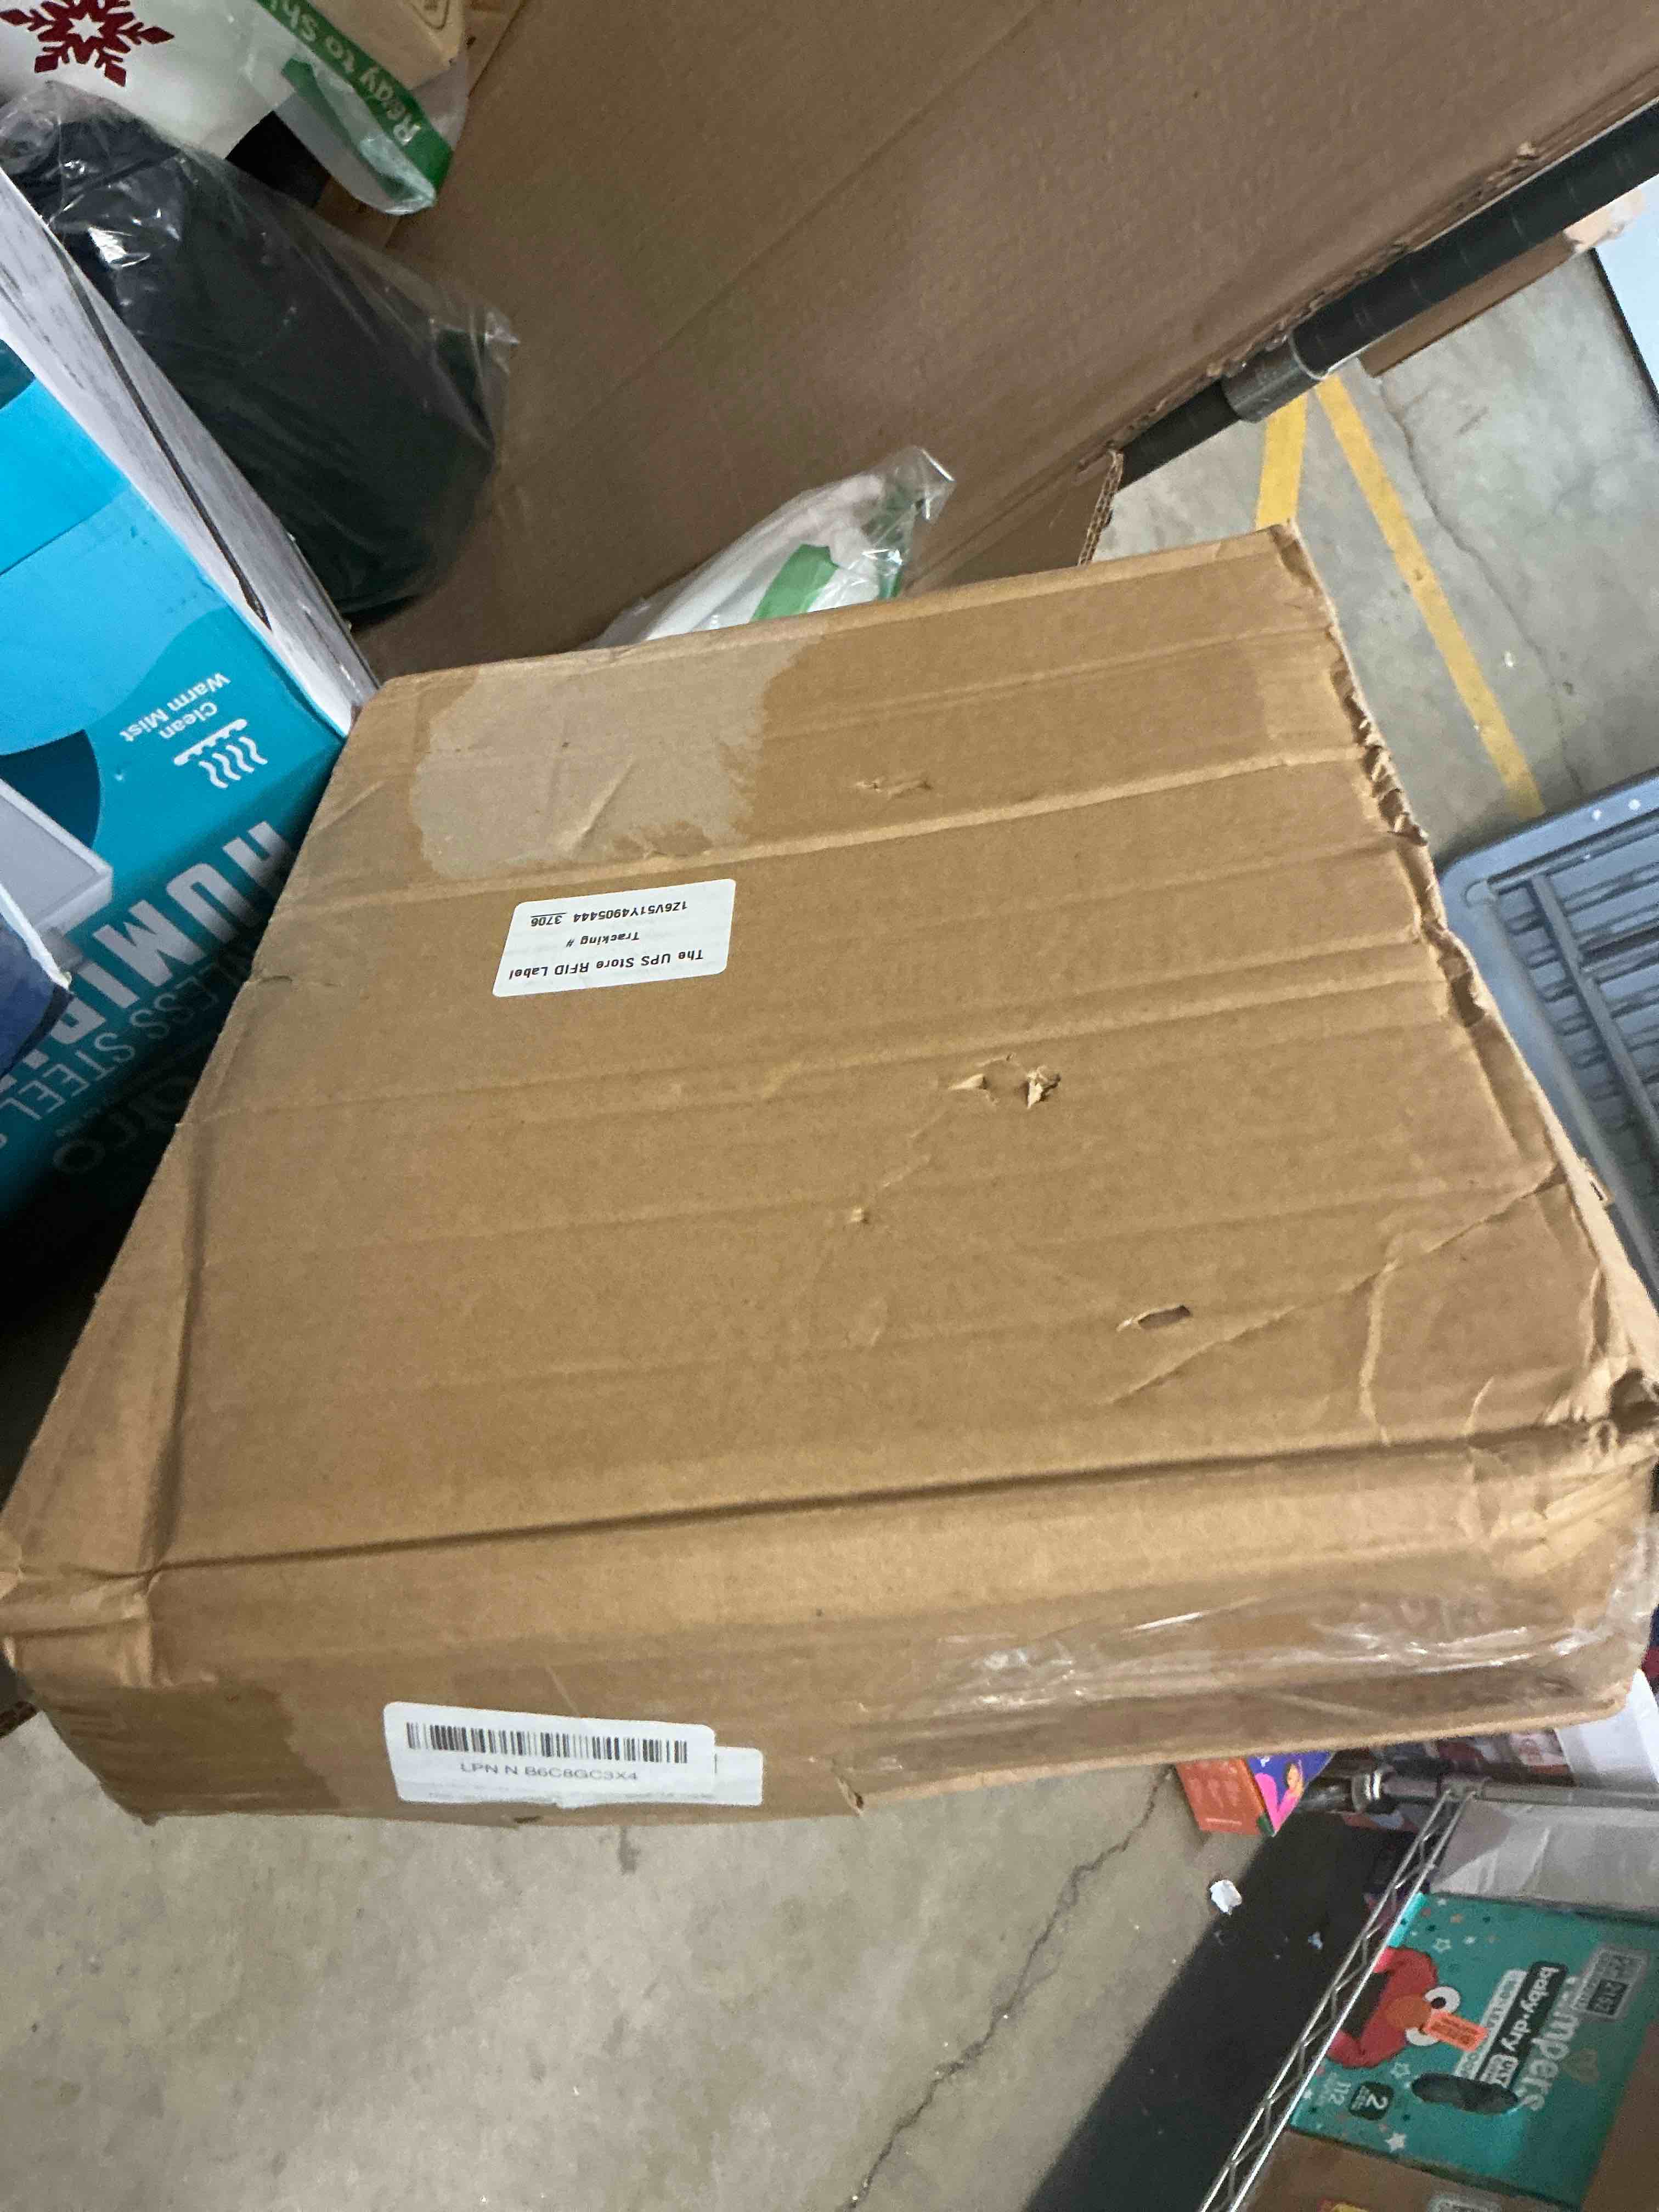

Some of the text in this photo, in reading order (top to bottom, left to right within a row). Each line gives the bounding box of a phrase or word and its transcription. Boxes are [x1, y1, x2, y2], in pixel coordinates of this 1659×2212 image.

[325, 35, 356, 74] to
[119, 672, 231, 742] Warm Mist
[159, 702, 217, 738] Clean
[531, 900, 688, 927] 1Z6V51Y4905444 3706
[566, 932, 640, 948] Tracking #
[509, 949, 704, 980] The UPS Store RFID Label
[0, 1032, 137, 1121] STEEL
[460, 1762, 499, 1775] LPN
[505, 1765, 518, 1776] N
[1513, 1975, 1581, 2111] mpers
[1365, 2093, 1389, 2109] 2
